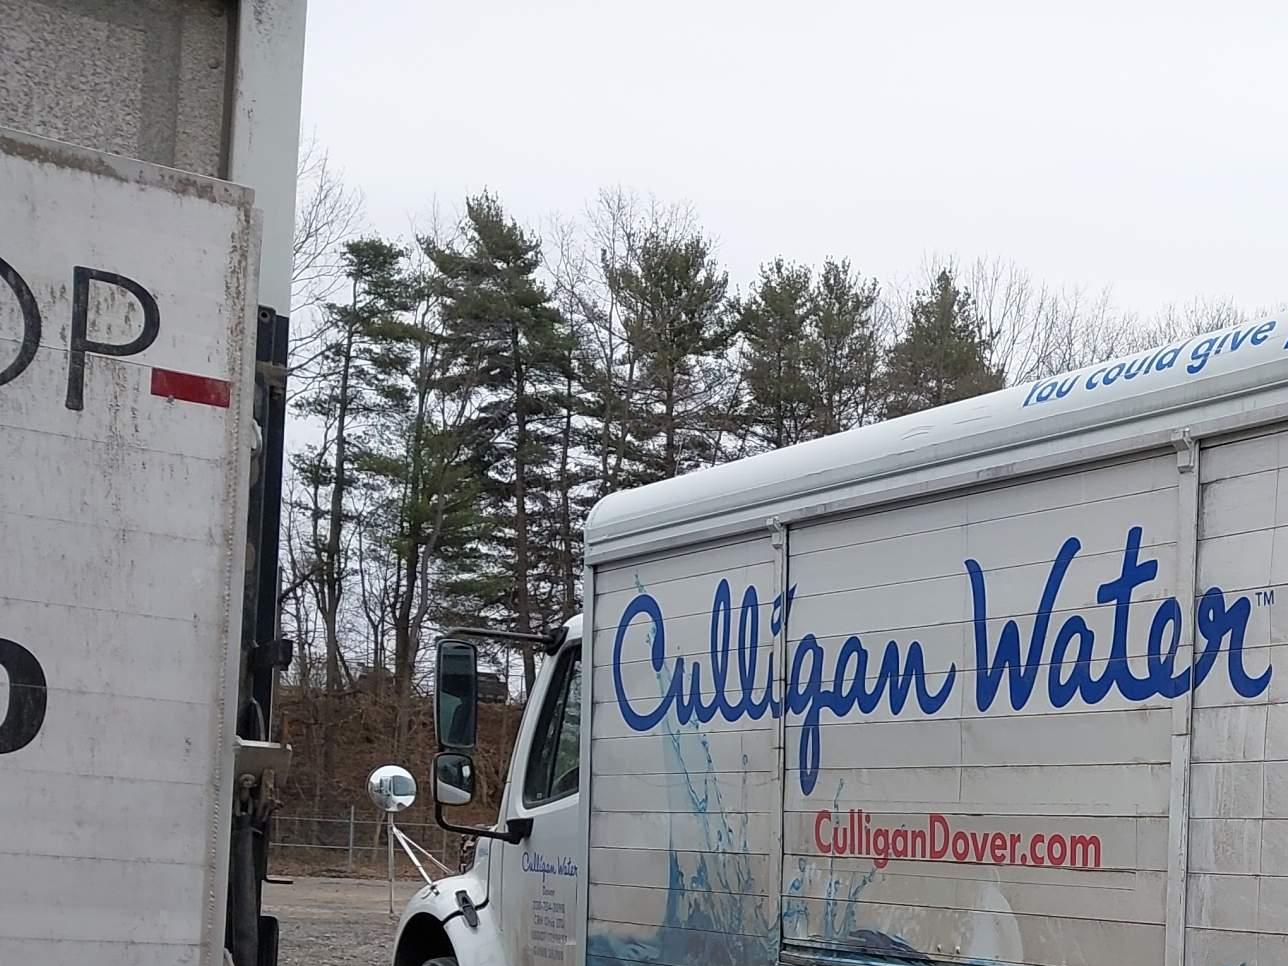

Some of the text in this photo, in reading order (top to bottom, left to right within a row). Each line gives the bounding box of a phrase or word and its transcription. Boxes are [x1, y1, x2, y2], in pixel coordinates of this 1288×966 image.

[1023, 379, 1078, 407] You
[1085, 340, 1188, 391] could
[1186, 318, 1276, 374] give
[612, 577, 956, 796] Culligan
[964, 525, 1273, 713] Water
[521, 851, 578, 883] Culligan Water
[814, 807, 1102, 870] CulliganDover.com
